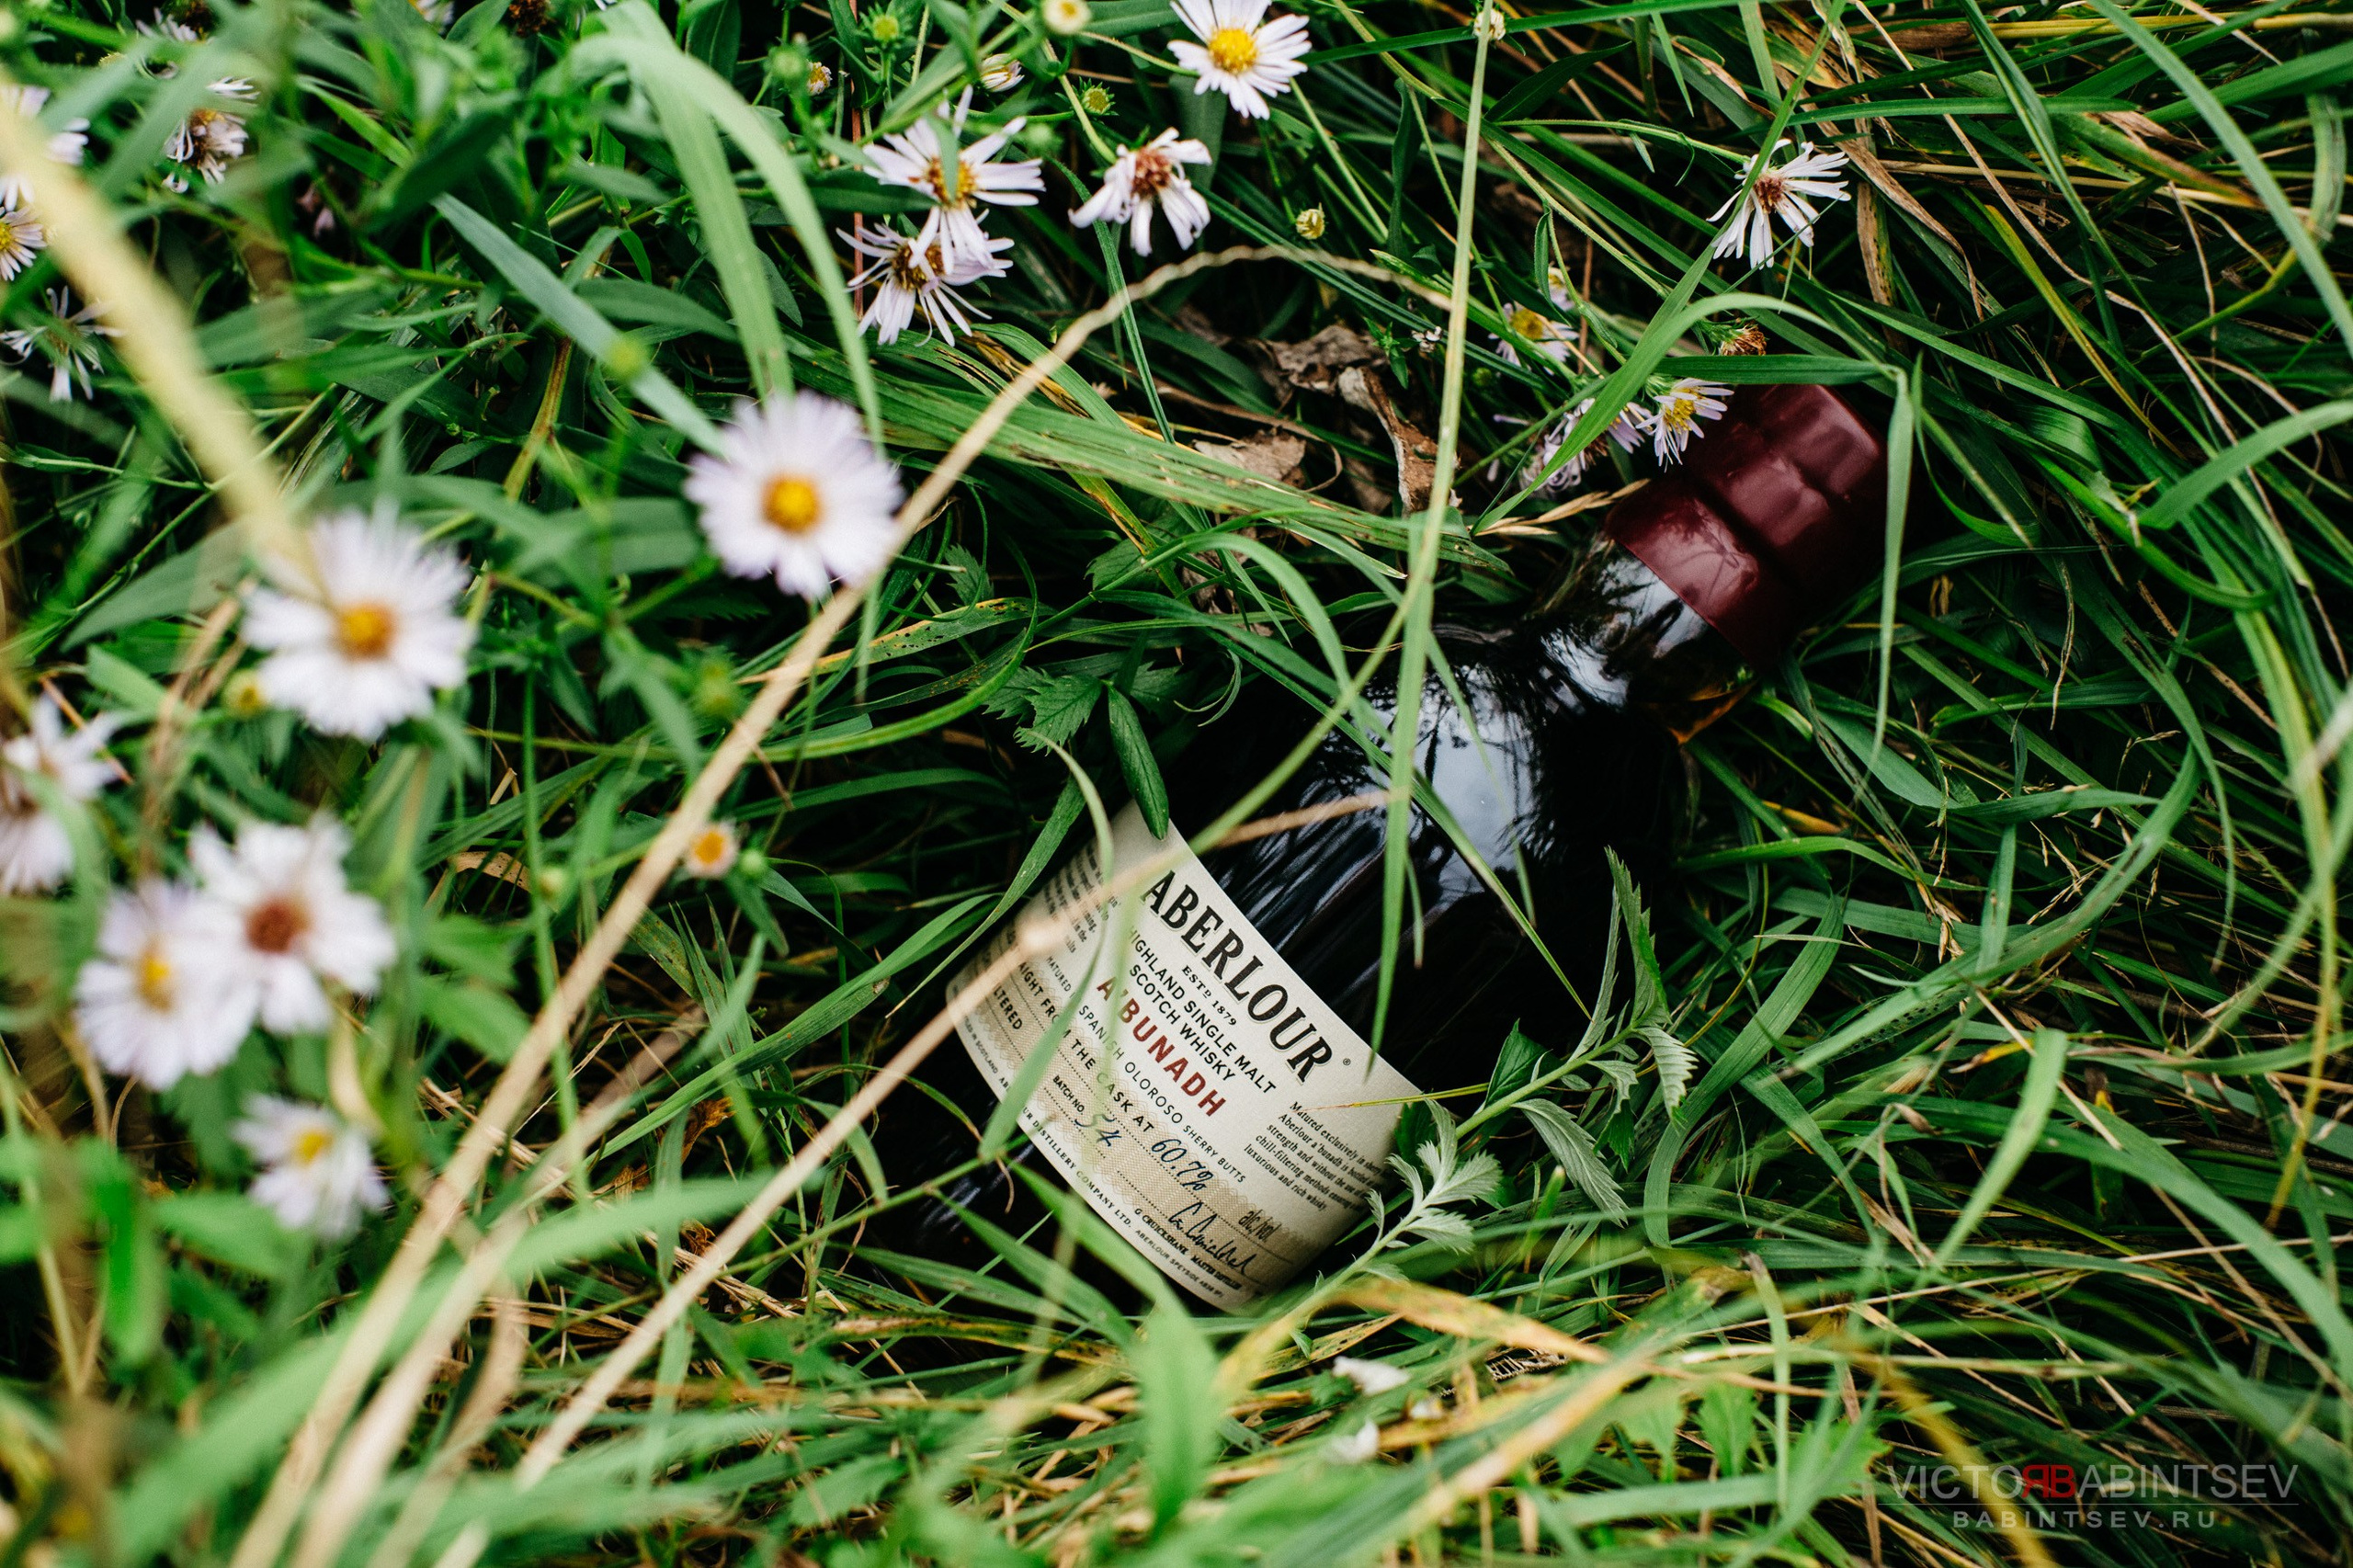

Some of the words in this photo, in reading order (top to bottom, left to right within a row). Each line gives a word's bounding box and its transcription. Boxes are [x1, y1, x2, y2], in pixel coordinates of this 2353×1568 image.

[990, 980, 1024, 1030] LTERED
[1142, 870, 1332, 1083] ABERLOUR
[1125, 926, 1185, 999] HIGHLAND
[1184, 1001, 1236, 1056] SINGLE
[1234, 1055, 1276, 1093] MALT
[1130, 965, 1180, 1024] SCOTCH
[1180, 1023, 1235, 1080] WHISKY
[1212, 1001, 1236, 1025] 1879
[1046, 956, 1071, 991] MATURED
[1079, 1006, 1124, 1060] SPANISH
[1125, 1062, 1182, 1123] OLOROSO
[1183, 1125, 1218, 1156] SHERRY
[1218, 1158, 1245, 1182] BUTTS
[1096, 977, 1226, 1117] A'BUNADH
[1053, 1075, 1074, 1100] BATCH
[1072, 1099, 1085, 1115] NO.
[1072, 1039, 1096, 1070] THE
[1096, 1072, 1133, 1112] CASK
[1132, 1116, 1154, 1131] AT
[1152, 1139, 1213, 1190] 60.7%
[1074, 1112, 1123, 1148] 54
[1267, 1125, 1298, 1152] strength
[1297, 1151, 1313, 1163] and
[1312, 1161, 1336, 1180] without
[1279, 1114, 1313, 1142] Aberlour
[1311, 1142, 1343, 1166] a'bunadh
[1340, 1163, 1348, 1171] is
[1290, 1102, 1323, 1131] Matured
[1321, 1131, 1358, 1160] exclusively
[1357, 1156, 1365, 1165] in
[976, 1040, 998, 1074] SCOTLAND
[1033, 1120, 1075, 1168] DISTILLERY
[1076, 1170, 1114, 1208] COMPANY
[1115, 1210, 1132, 1227] LTD.
[1135, 1231, 1170, 1258] ABERLOUR
[1170, 1259, 1199, 1281] SPEYSIDE
[1245, 1143, 1279, 1176] luxurious
[1279, 1175, 1294, 1187] and
[1291, 1185, 1307, 1197] rich
[1256, 1136, 1304, 1177] chill-filtering
[1302, 1175, 1330, 1194] methods
[1142, 1215, 1188, 1255] CRUICKSHANK
